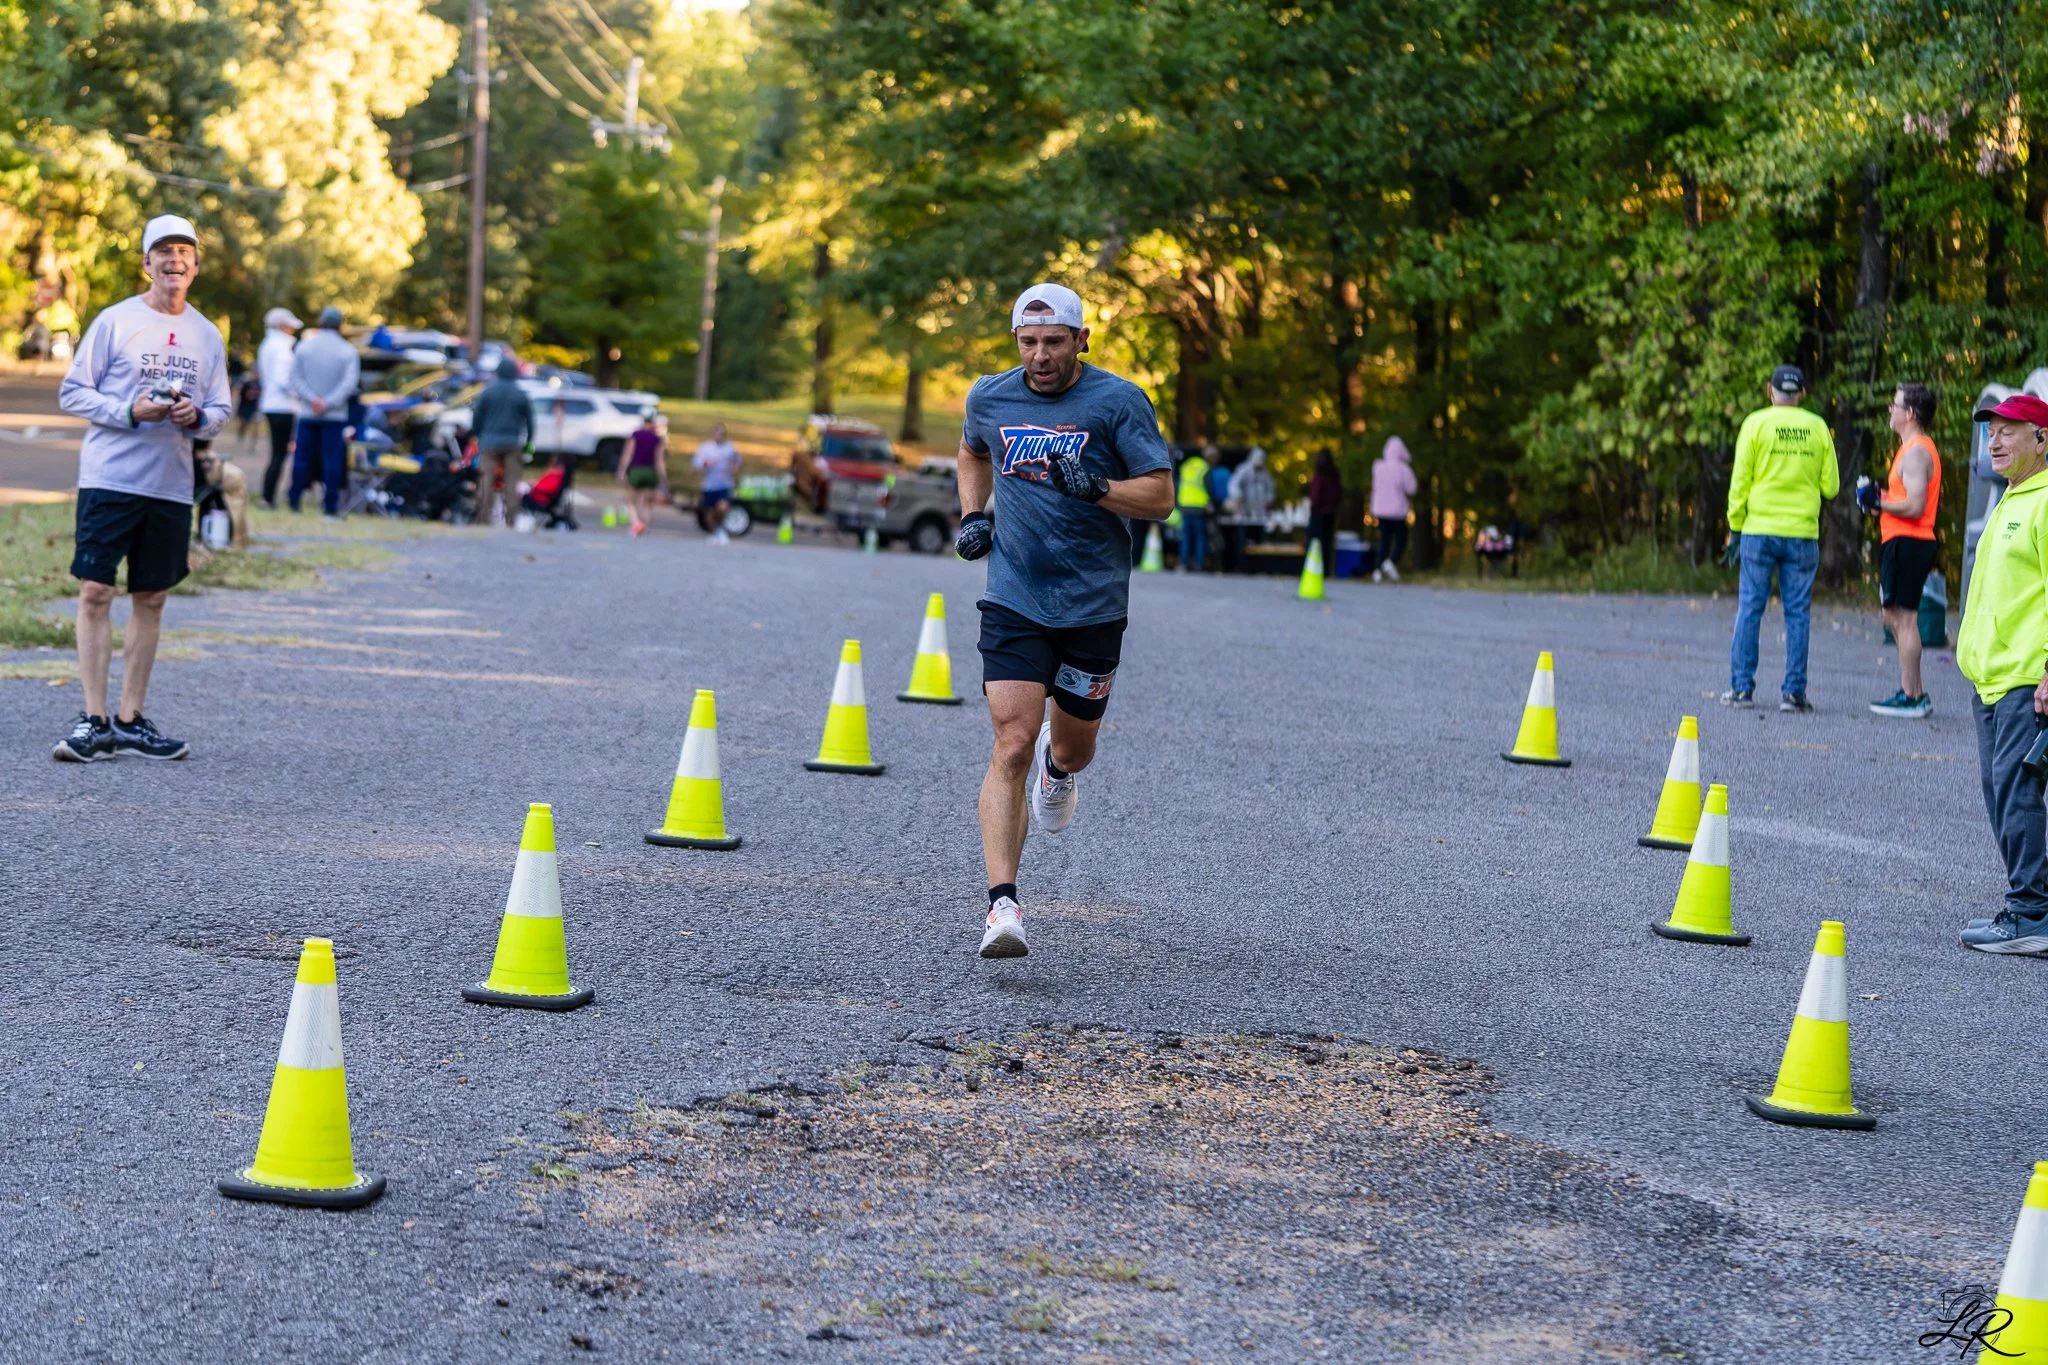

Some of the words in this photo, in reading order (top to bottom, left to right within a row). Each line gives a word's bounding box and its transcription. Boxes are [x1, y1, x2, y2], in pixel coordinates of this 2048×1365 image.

[141, 353, 161, 366] ST.
[163, 355, 199, 373] JUDE
[140, 368, 198, 386] MEMPHIS
[999, 424, 1090, 475] THUNDER
